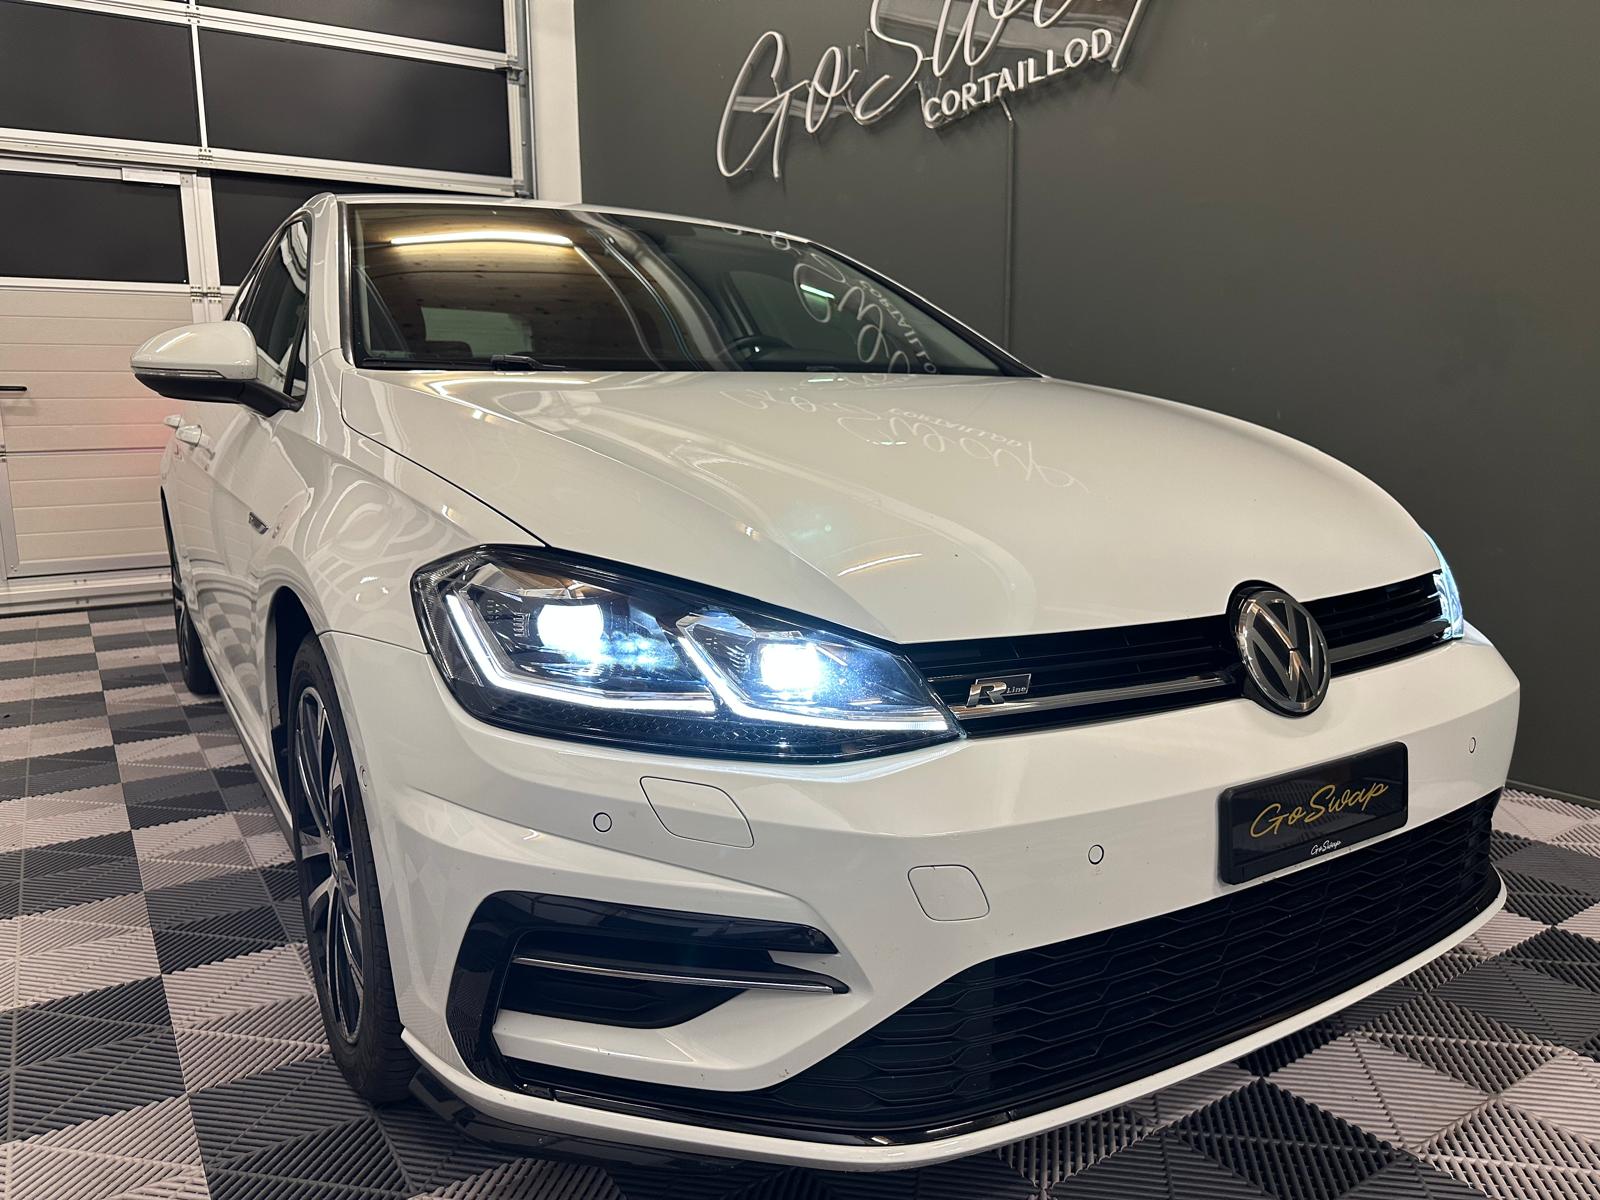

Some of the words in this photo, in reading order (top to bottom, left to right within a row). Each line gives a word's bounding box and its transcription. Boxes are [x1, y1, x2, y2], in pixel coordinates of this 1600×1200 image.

[923, 28, 1113, 124] CORTAILLOD
[965, 681, 1007, 708] R
[1250, 782, 1389, 838] GoSwap
